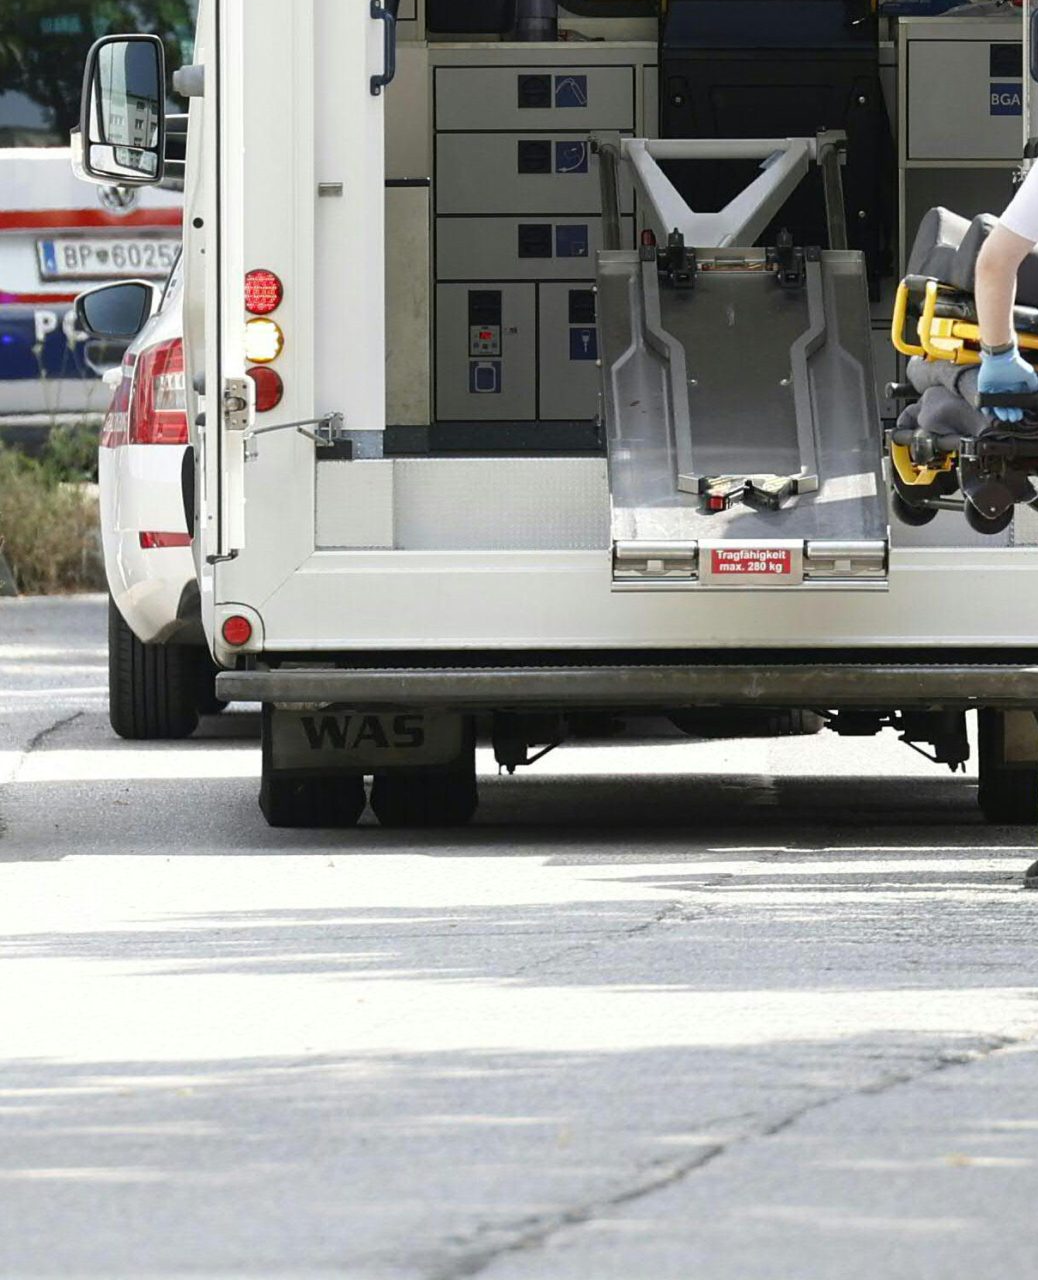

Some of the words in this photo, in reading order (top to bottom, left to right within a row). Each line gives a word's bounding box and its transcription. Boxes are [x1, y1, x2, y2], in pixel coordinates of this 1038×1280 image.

[991, 93, 1020, 105] BGA
[64, 245, 91, 268] BP
[716, 549, 786, 561] Tragfähigkeit
[719, 563, 745, 571] max.
[747, 562, 767, 571] 280
[769, 562, 783, 573] kg
[300, 714, 425, 750] WAS
